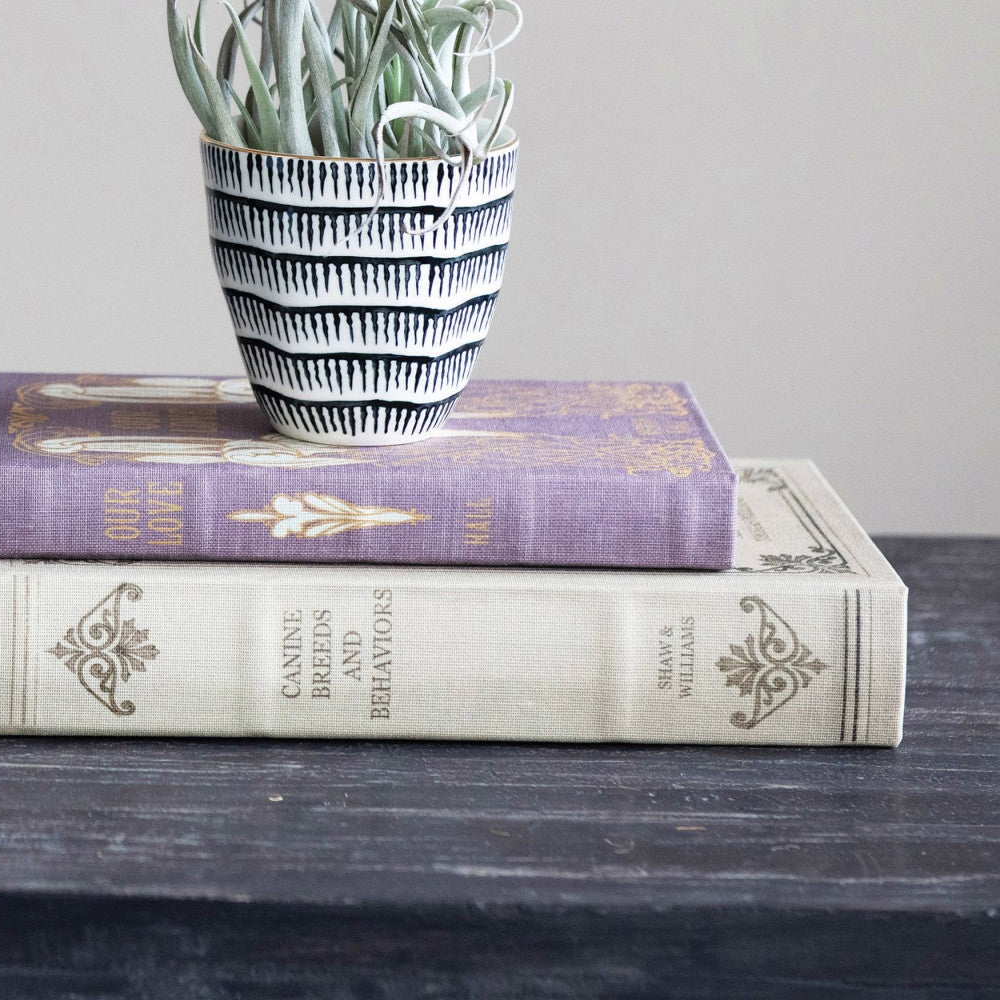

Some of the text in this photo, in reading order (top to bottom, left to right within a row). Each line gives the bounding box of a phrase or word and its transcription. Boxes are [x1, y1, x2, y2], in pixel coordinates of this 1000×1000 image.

[104, 488, 141, 541] OUR
[147, 481, 183, 546] LOVE
[281, 609, 303, 700] CANINE
[311, 609, 332, 700] BREEDS
[342, 630, 363, 682] AND
[370, 589, 394, 720] BEHAVIORS
[657, 625, 674, 690] SHAW &
[678, 616, 695, 699] WILLIAMS
